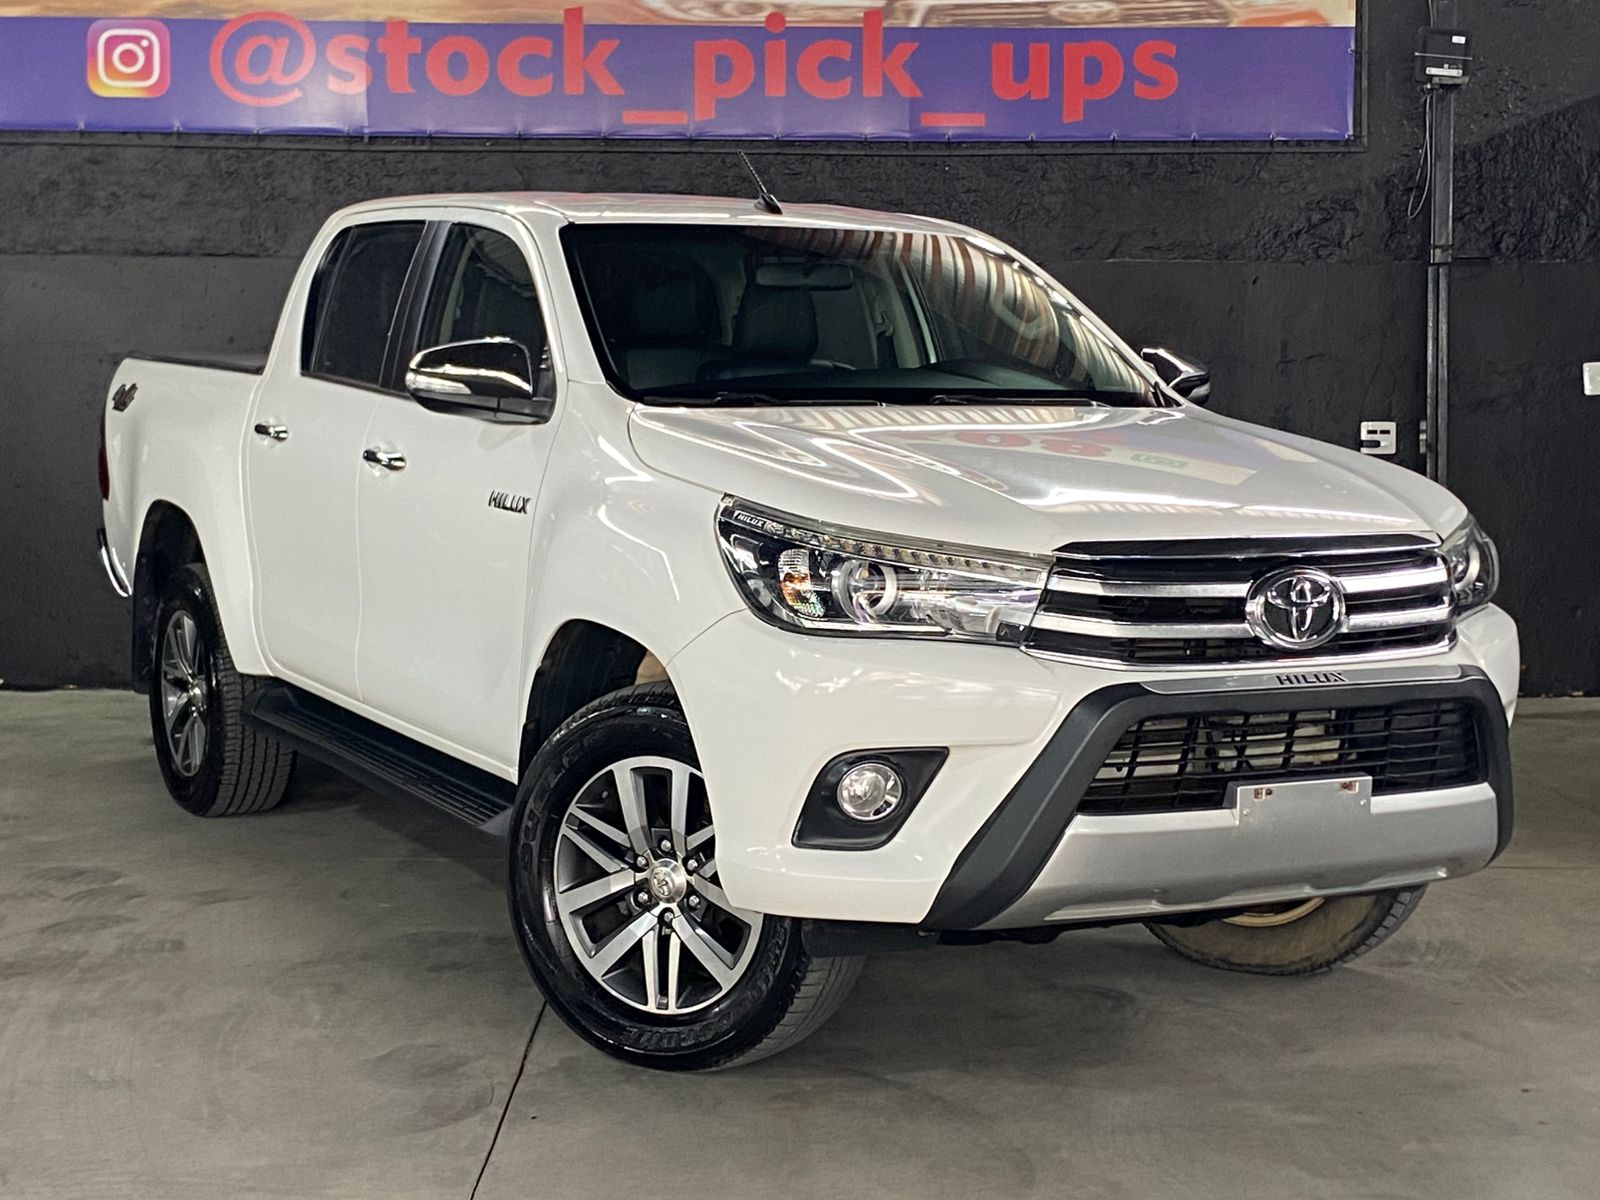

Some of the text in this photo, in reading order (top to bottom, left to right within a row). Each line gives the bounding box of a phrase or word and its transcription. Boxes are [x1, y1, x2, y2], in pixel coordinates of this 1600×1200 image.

[209, 6, 1180, 126] @stock_pick_ups
[487, 490, 532, 515] HILUX
[738, 513, 764, 527] HILUX
[1275, 671, 1346, 686] HILUX
